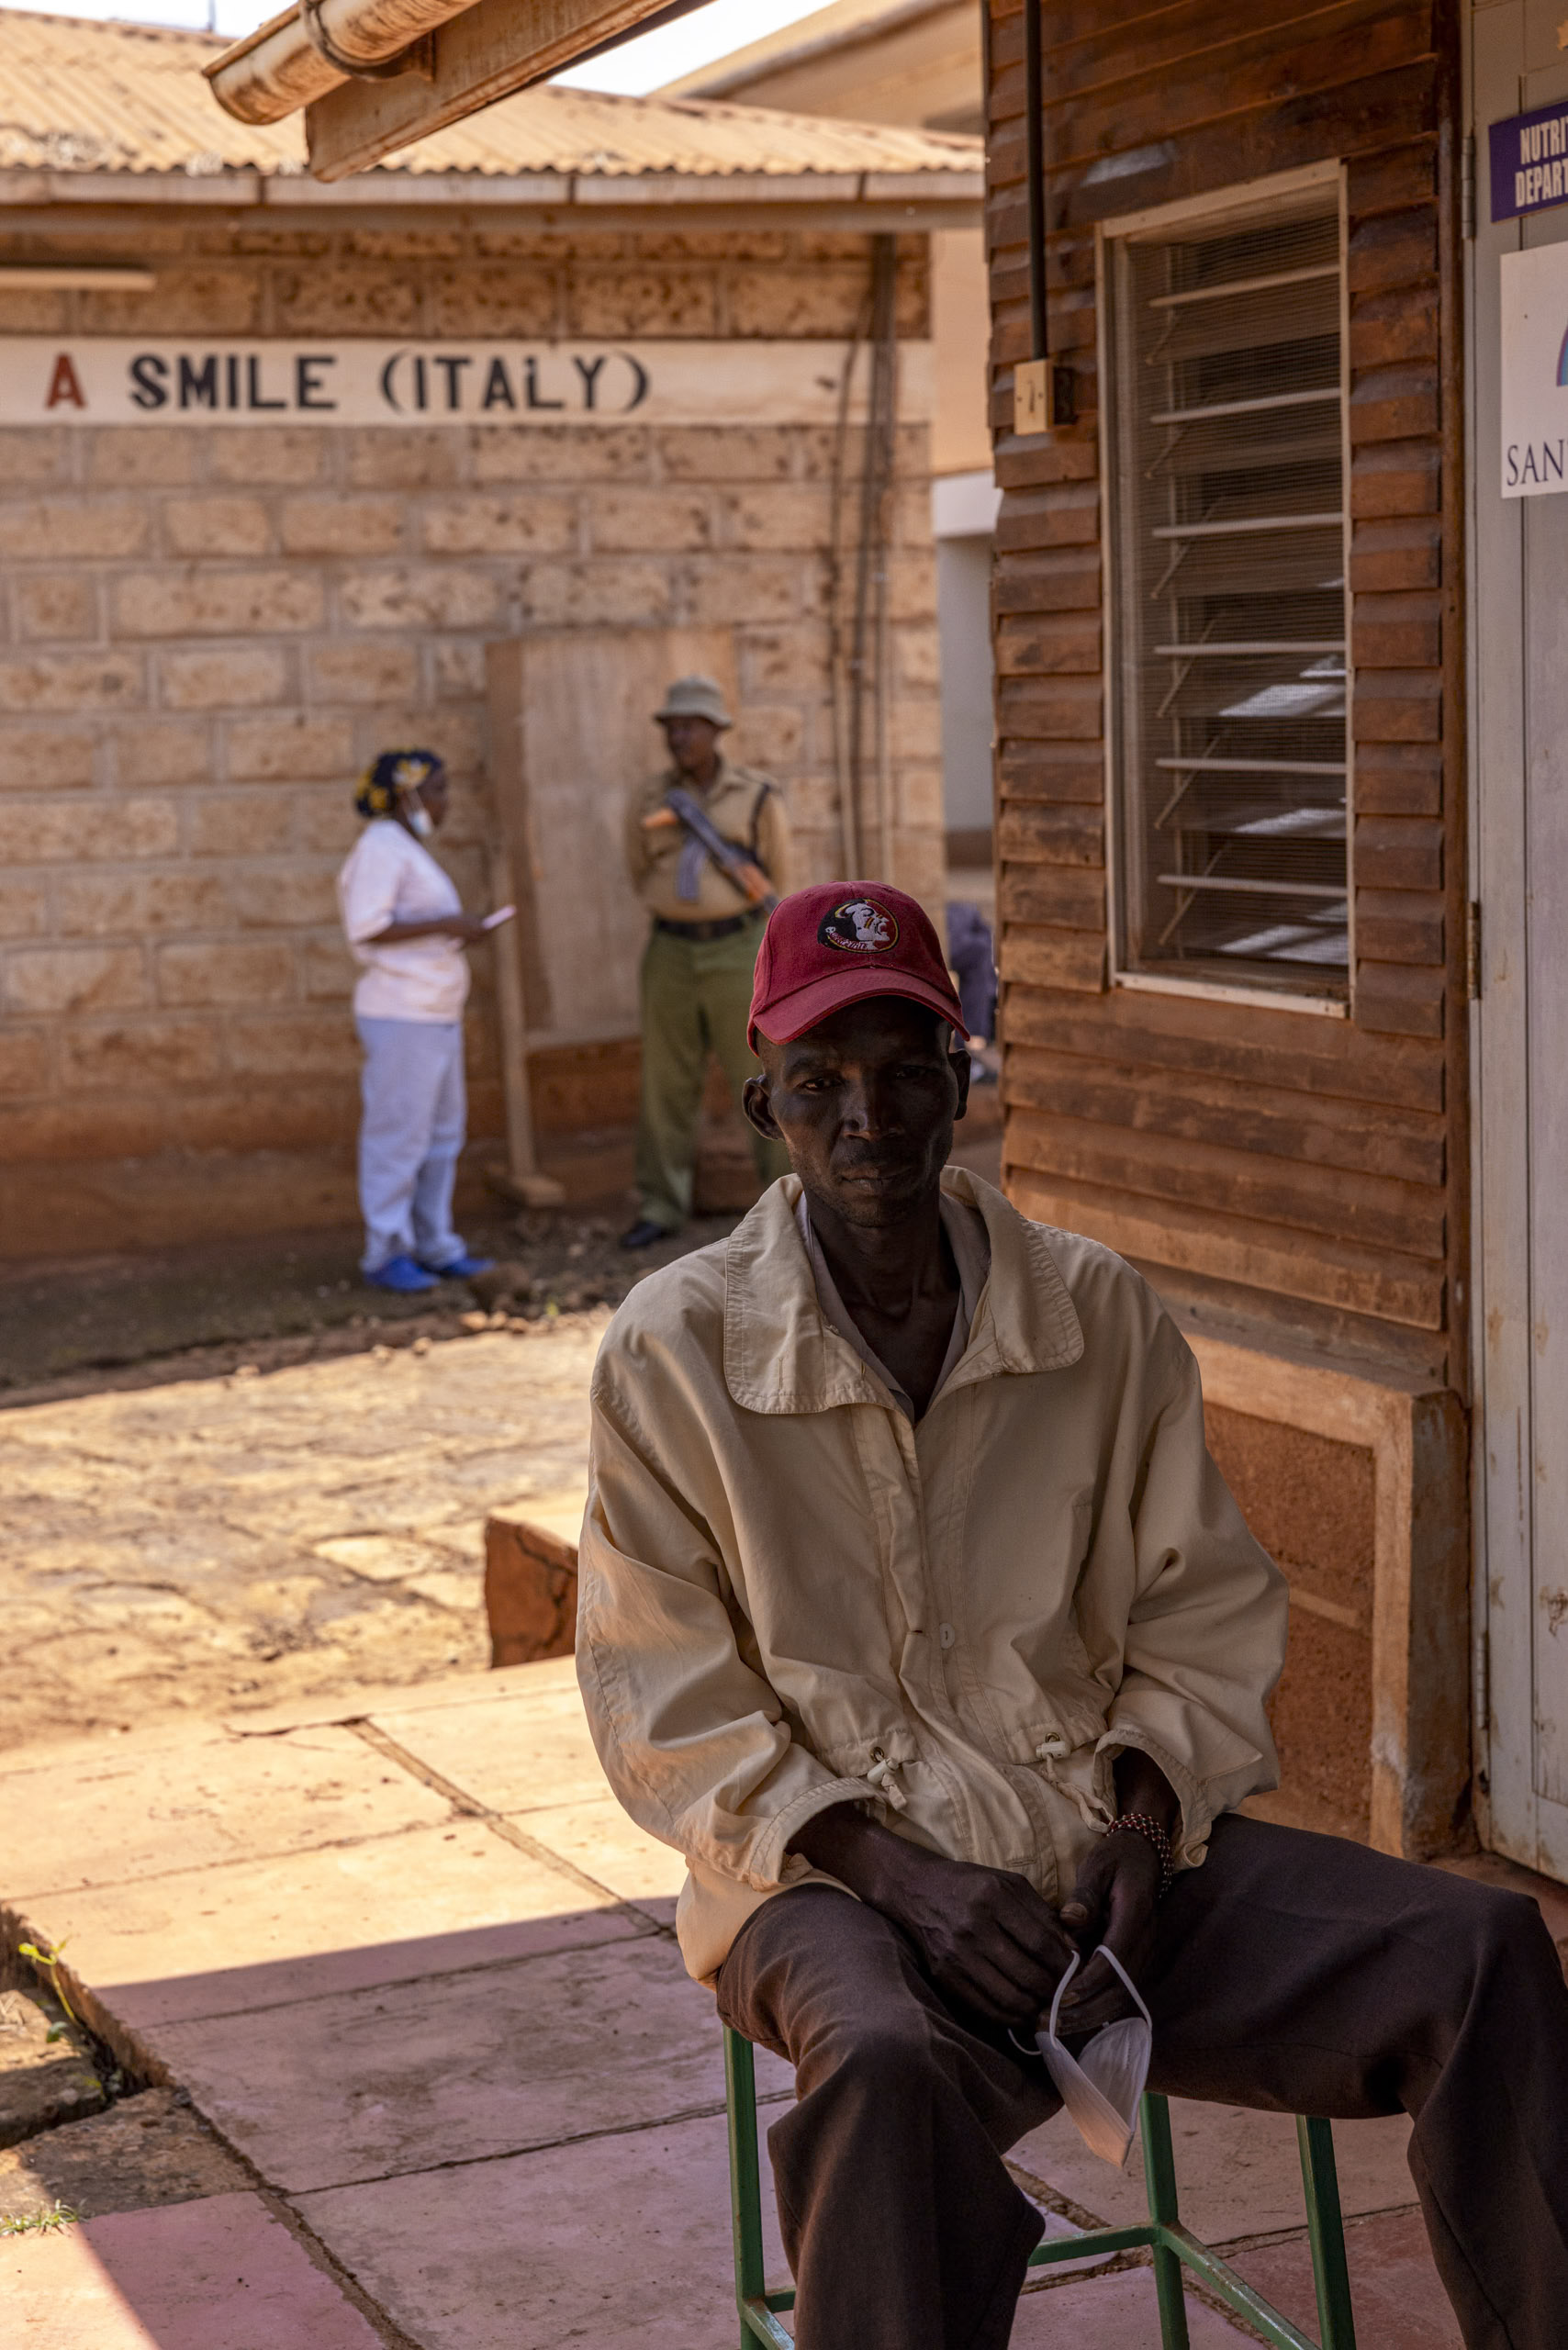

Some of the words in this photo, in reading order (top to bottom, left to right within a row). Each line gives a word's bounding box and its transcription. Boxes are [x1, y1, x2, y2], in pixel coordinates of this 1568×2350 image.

[1520, 115, 1568, 164] NUTRI
[45, 352, 87, 410] A
[129, 353, 338, 411] SMILE
[379, 348, 650, 415] (ITALY)
